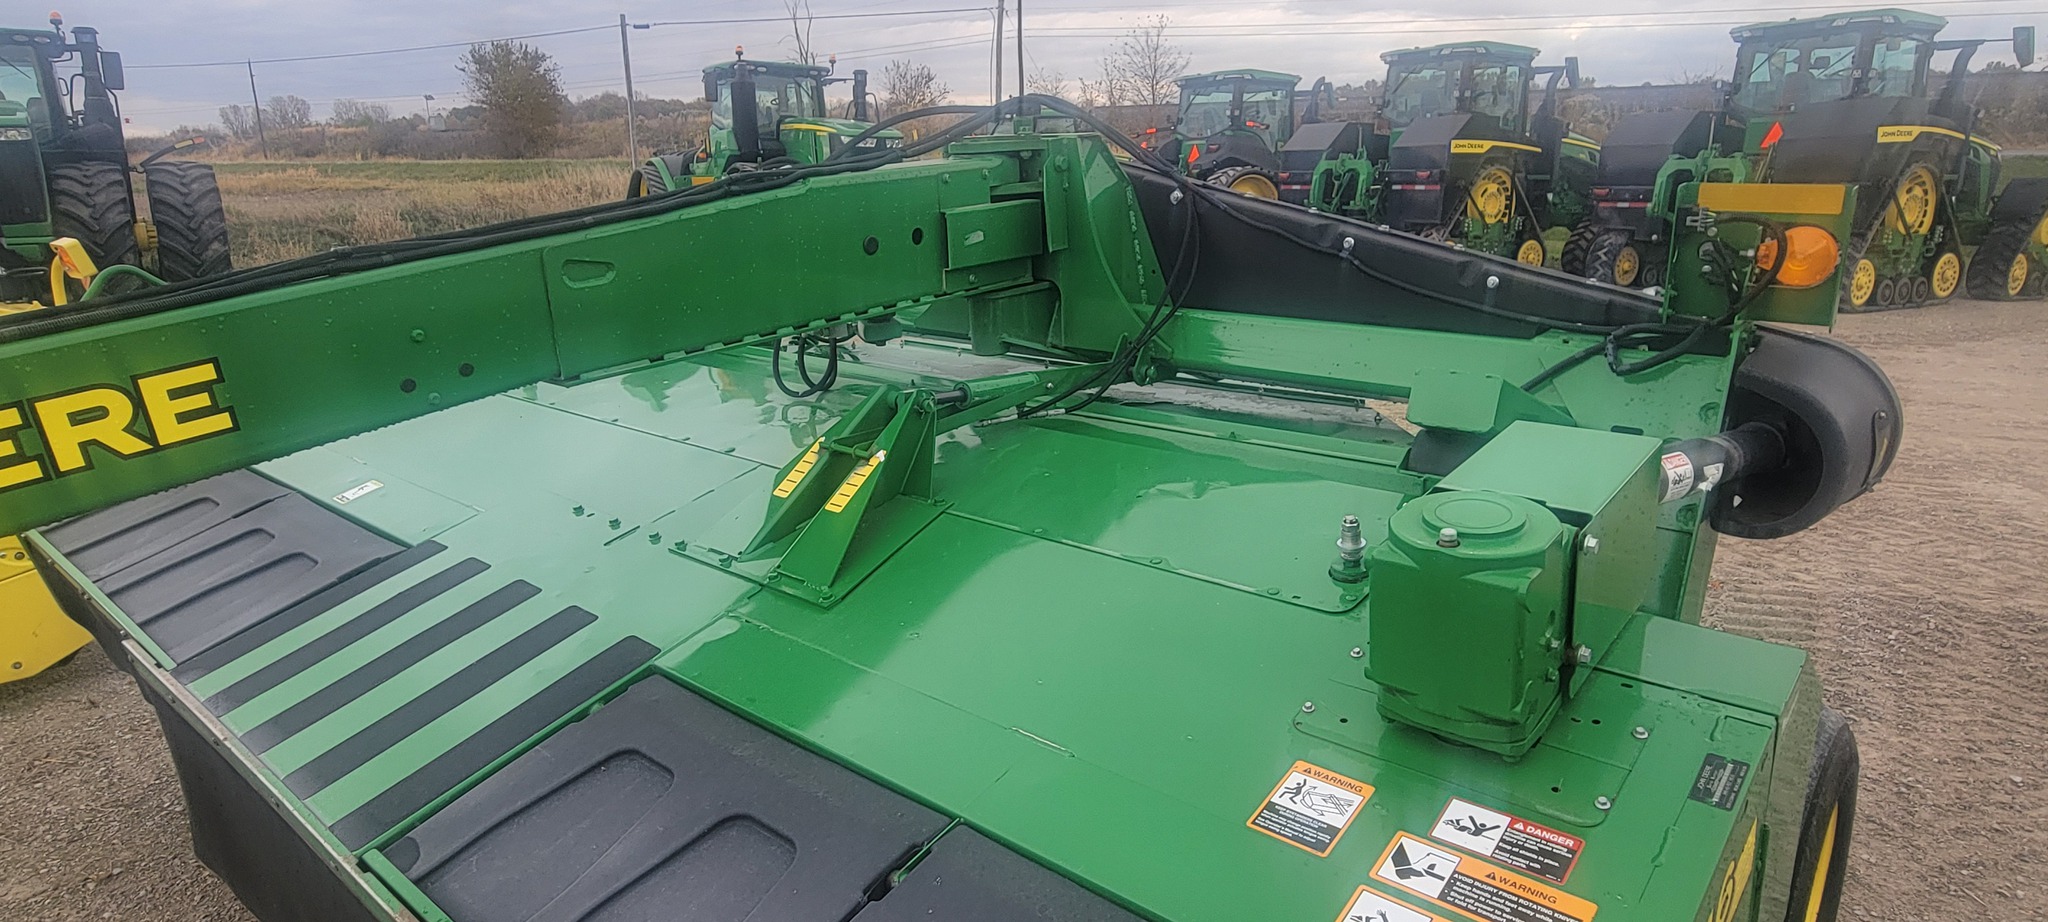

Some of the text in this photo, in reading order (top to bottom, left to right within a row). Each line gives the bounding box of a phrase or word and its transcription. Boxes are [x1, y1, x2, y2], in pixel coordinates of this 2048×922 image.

[1313, 770, 1363, 793] WARNING
[1525, 825, 1575, 847] DANGER
[1452, 886, 1479, 898] machine
[1485, 899, 1512, 913] running.
[1453, 874, 1474, 884] AVOID
[1474, 881, 1499, 894] INJURY
[1498, 890, 1518, 901] FROM
[1518, 898, 1553, 916] ROTATING
[1454, 899, 1467, 907] fold
[1456, 882, 1472, 891] Keep
[1472, 888, 1492, 898] hands
[1505, 901, 1518, 909] feet
[1518, 907, 1535, 916] away
[1499, 876, 1558, 904] WARNING
[1450, 891, 1465, 900] Shut
[1474, 902, 1494, 912] power
[1503, 912, 1526, 922] servic
